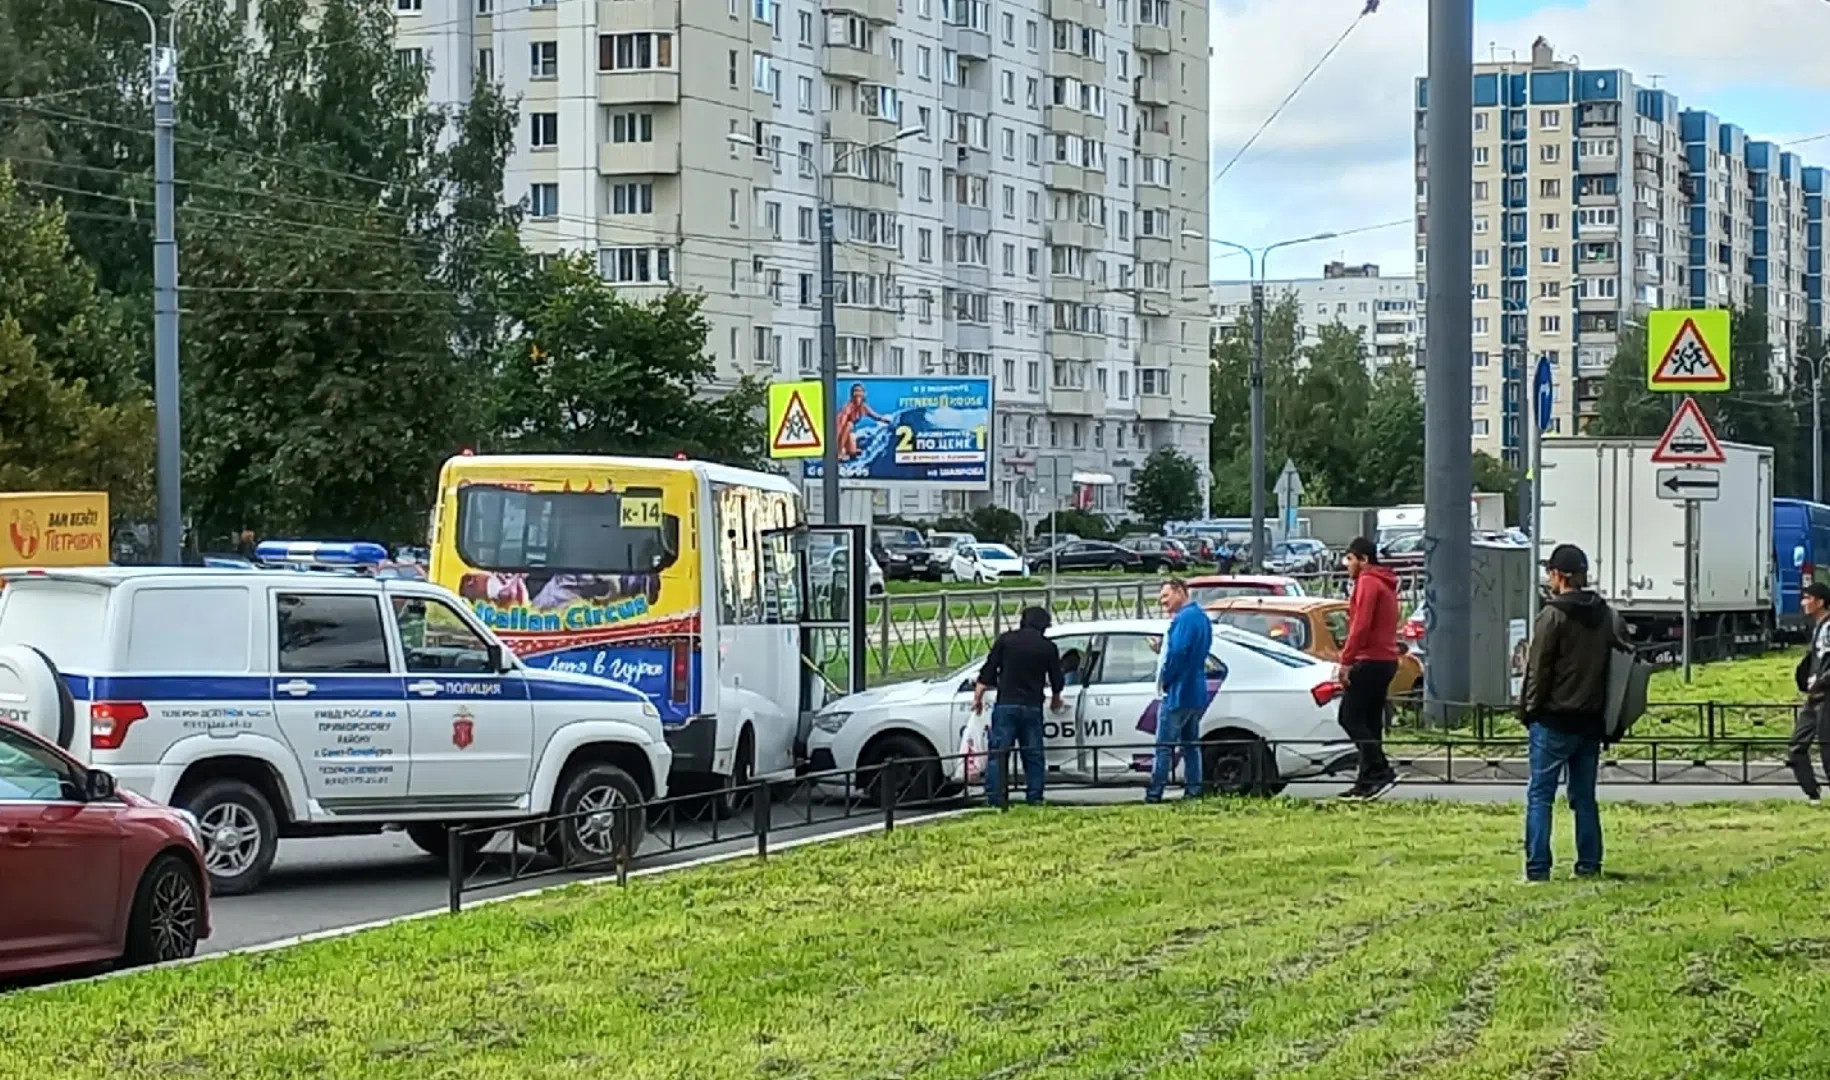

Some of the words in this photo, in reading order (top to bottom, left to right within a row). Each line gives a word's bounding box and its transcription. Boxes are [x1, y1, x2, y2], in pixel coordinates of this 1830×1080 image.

[895, 425, 913, 451] 2
[916, 438, 936, 450] ПО
[938, 438, 972, 451] ЦЕНЕ
[975, 424, 986, 450] 1
[474, 602, 561, 632] Italian
[565, 595, 649, 630] Circus
[445, 682, 501, 697] ПОЛИЦИЯ
[318, 722, 391, 732] ПРИМОРСКОМУ
